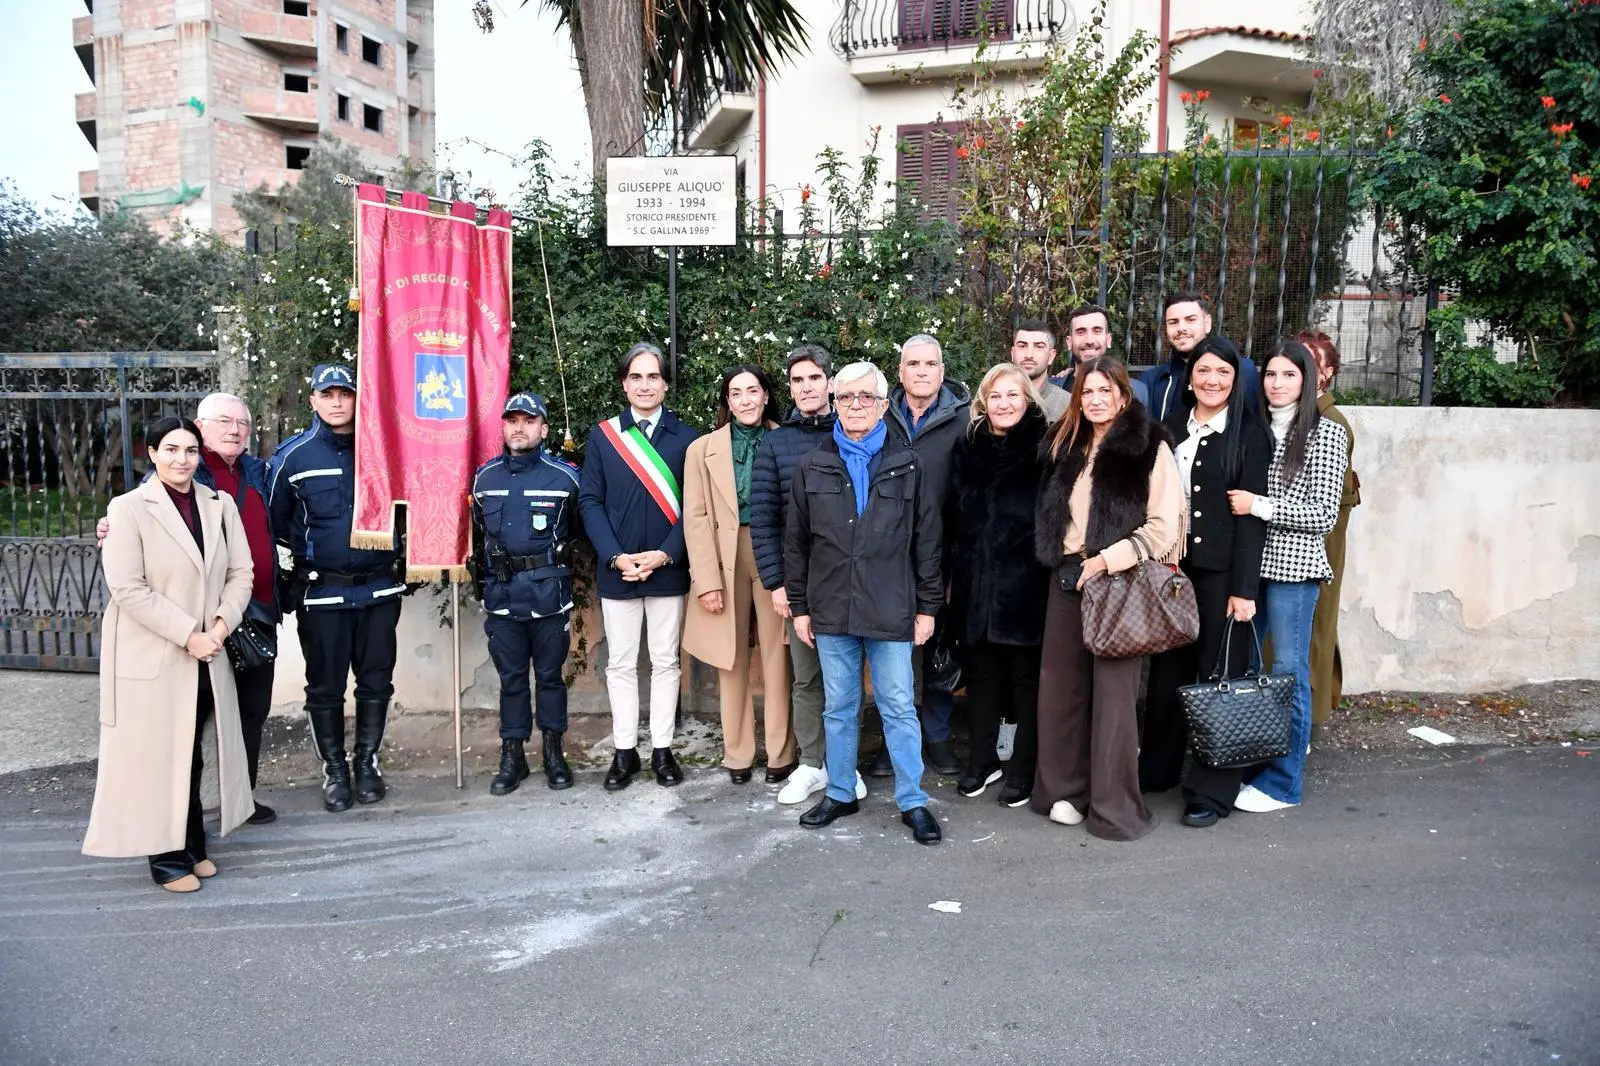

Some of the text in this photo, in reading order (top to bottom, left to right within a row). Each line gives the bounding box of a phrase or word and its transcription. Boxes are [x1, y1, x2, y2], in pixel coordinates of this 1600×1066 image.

[664, 168, 679, 176] VIA
[618, 182, 671, 192] GIUSEPPE
[636, 198, 663, 208] 1933
[679, 198, 706, 208] 1994
[626, 213, 717, 222] STORICO PRESIDENTE
[650, 227, 687, 235] GALLINA
[395, 277, 409, 289] DI
[412, 273, 459, 287] REGGIO
